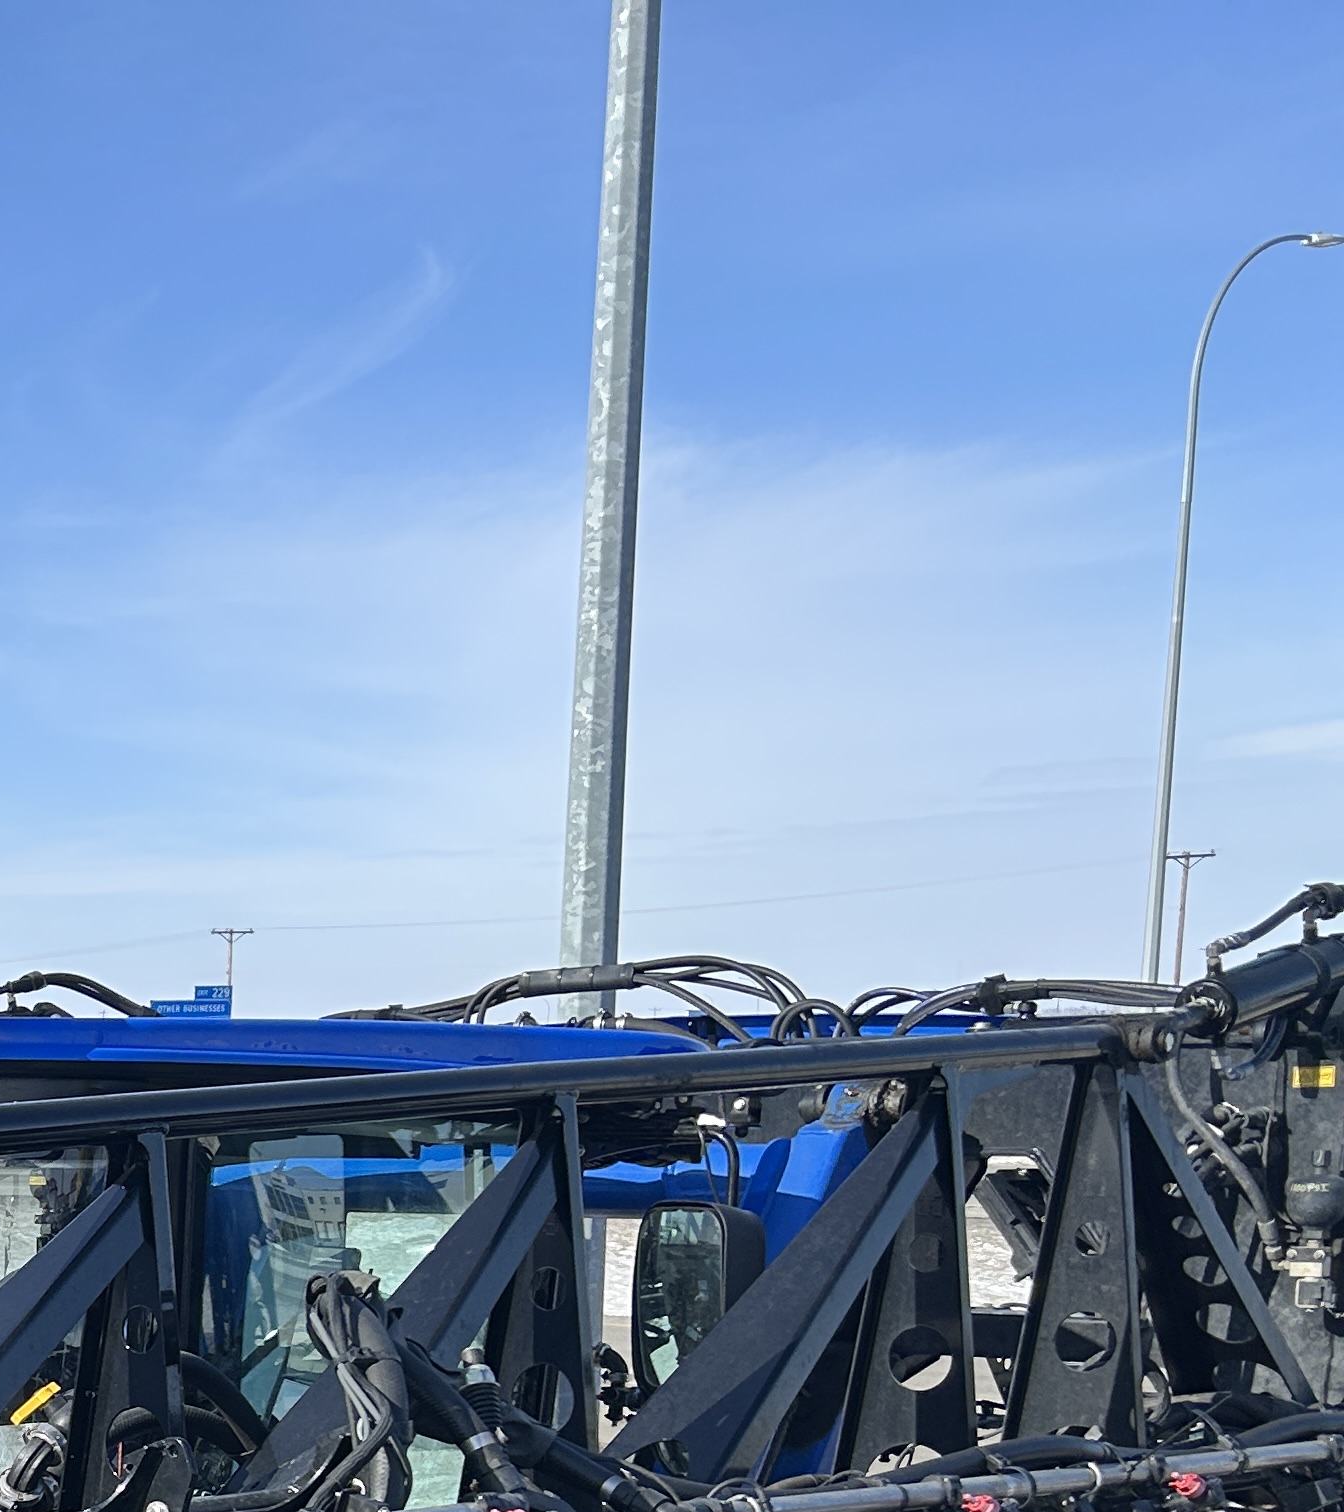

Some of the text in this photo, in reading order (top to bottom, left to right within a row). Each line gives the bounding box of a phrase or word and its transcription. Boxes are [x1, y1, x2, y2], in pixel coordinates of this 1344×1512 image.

[212, 987, 230, 998] 229
[157, 1004, 225, 1013] OTHER BUSINESSES
